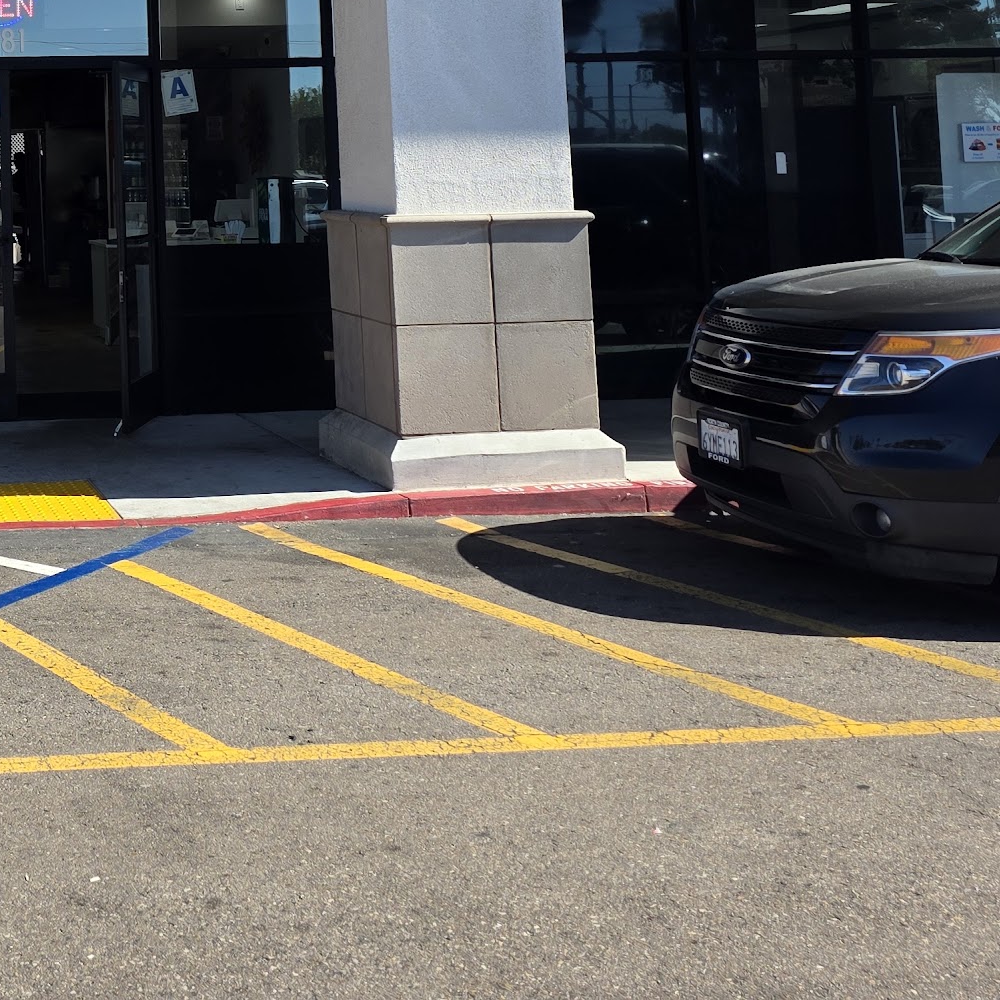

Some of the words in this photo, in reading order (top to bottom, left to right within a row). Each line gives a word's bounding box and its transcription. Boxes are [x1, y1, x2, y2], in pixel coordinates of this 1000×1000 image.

[170, 76, 189, 98] A
[722, 346, 741, 362] Ford
[707, 452, 730, 464] FORD
[534, 480, 633, 490] PARKING
